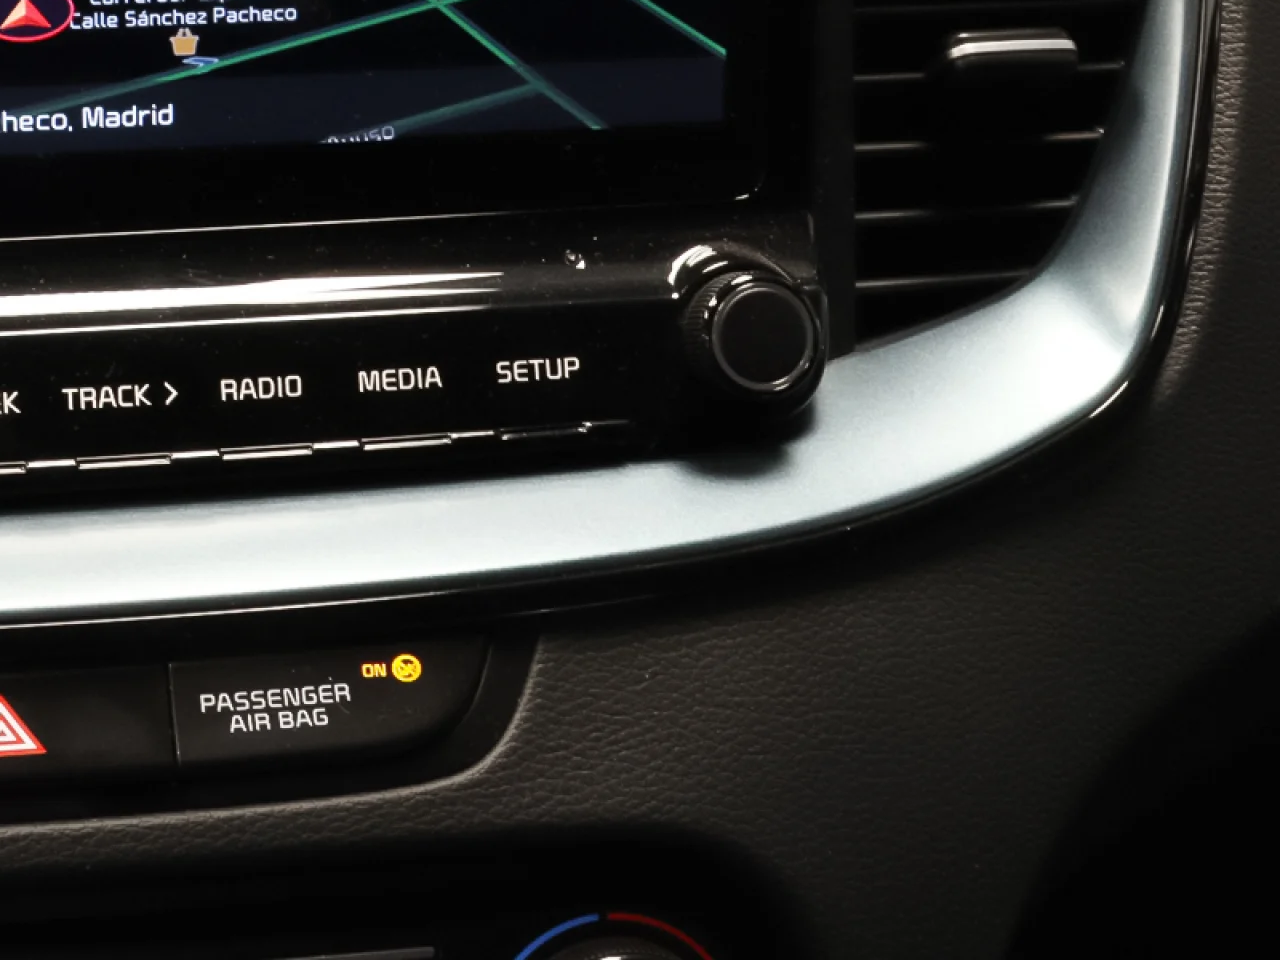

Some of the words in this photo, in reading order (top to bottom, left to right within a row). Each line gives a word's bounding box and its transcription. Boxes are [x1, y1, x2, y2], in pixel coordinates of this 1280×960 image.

[70, 10, 119, 31] Calle
[124, 6, 207, 28] Sánchez
[212, 4, 297, 24] Pacheco
[81, 102, 174, 130] Madrid
[356, 365, 443, 394] MEDIA
[495, 356, 581, 384] SETUP
[61, 383, 153, 411] TRACK
[219, 374, 303, 402] RADIO
[361, 663, 388, 678] ON
[199, 683, 352, 713] PASSENGER
[230, 714, 271, 734] AIR
[278, 707, 330, 730] BAG
